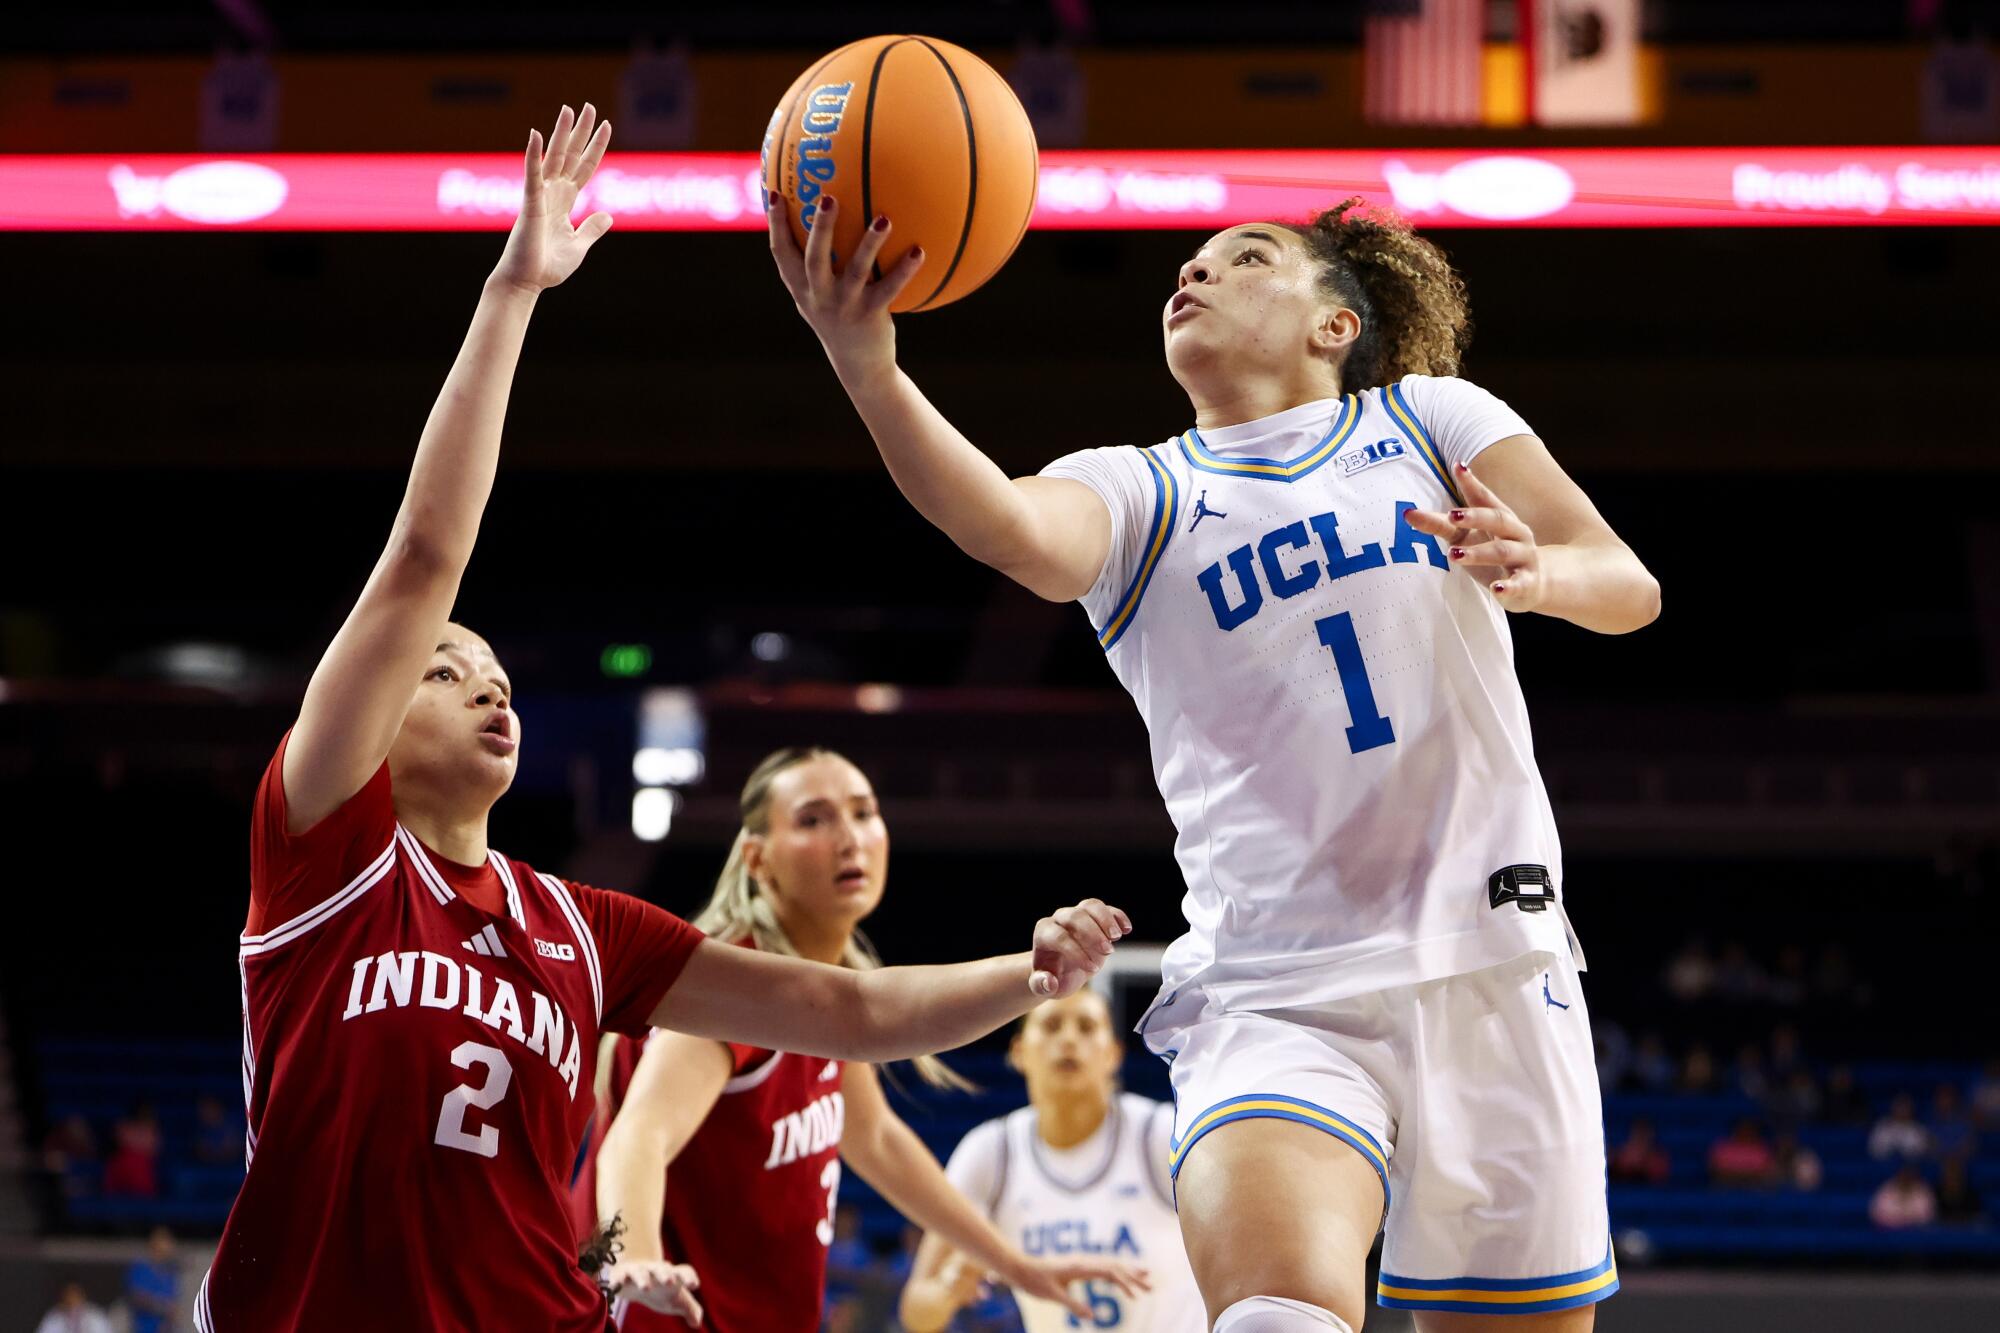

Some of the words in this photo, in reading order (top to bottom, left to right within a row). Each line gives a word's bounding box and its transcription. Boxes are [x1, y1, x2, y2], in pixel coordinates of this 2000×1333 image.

[797, 80, 854, 262] Wilso
[1197, 501, 1450, 631] UCLA
[1314, 611, 1396, 754] 1
[343, 950, 581, 1103] INDIANA
[434, 1041, 513, 1158] 2
[1022, 1220, 1140, 1257] UCLA
[1066, 1278, 1121, 1330] 5
